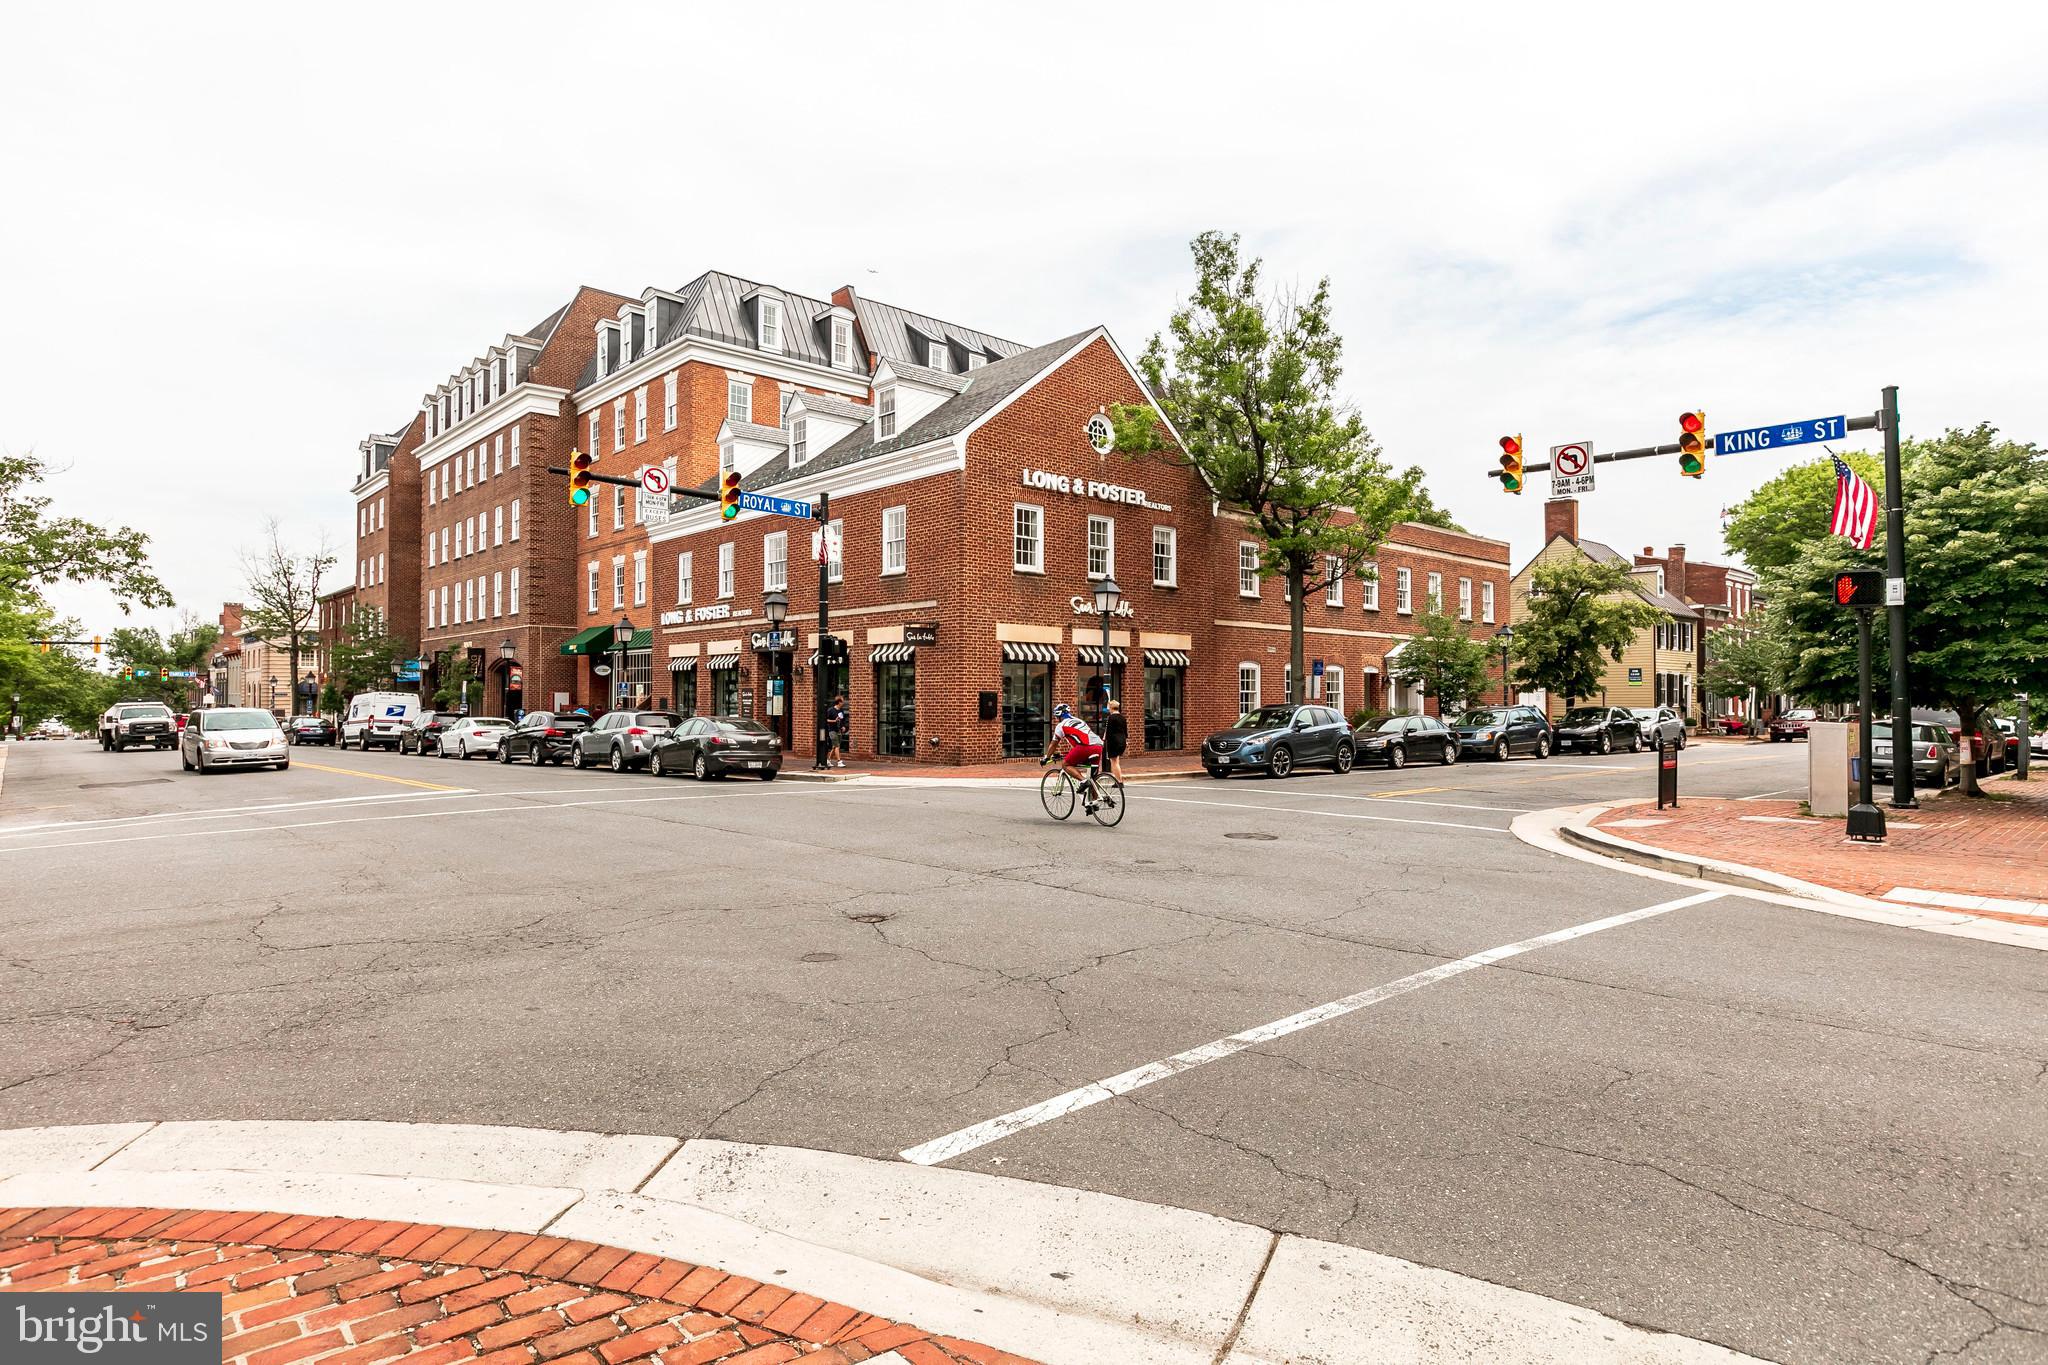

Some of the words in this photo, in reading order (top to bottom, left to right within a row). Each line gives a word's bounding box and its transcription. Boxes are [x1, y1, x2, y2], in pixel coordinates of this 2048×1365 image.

[1724, 430, 1770, 452] KING
[1814, 419, 1838, 440] ST
[1022, 468, 1069, 494] LONG
[1072, 478, 1085, 495] &
[1088, 481, 1146, 506] FOSTER
[742, 495, 778, 512] ROYAL
[794, 503, 808, 517] ST
[660, 610, 684, 626] LONG
[694, 604, 731, 622] FOSTER
